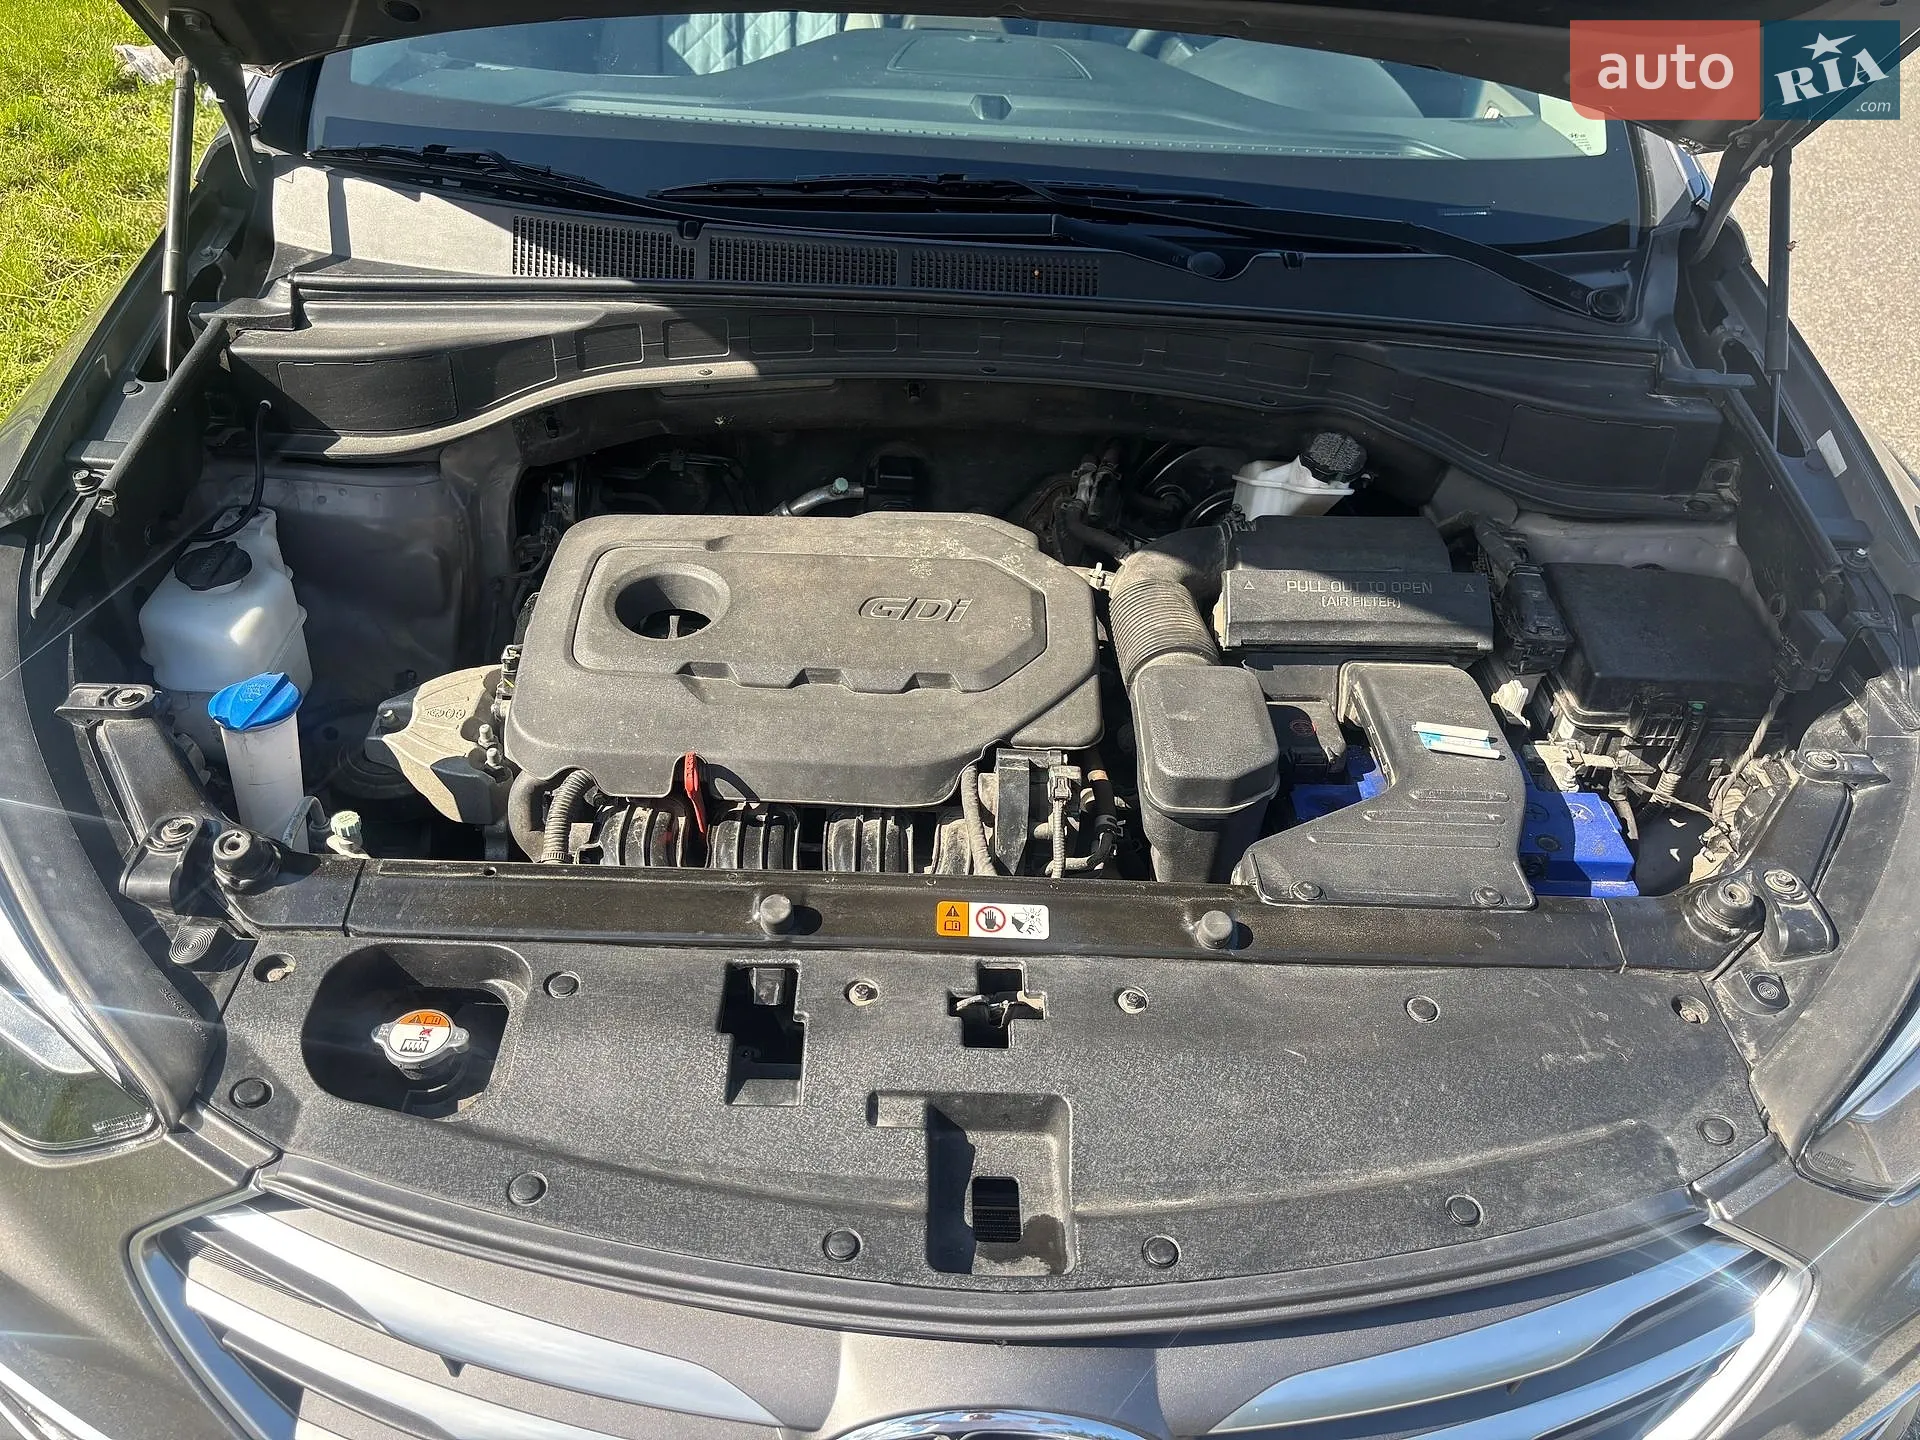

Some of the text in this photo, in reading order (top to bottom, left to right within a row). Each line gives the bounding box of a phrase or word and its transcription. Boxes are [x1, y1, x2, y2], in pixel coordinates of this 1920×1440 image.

[1286, 580, 1433, 594] PULL OUT TO OPEN
[858, 596, 974, 623] GDi
